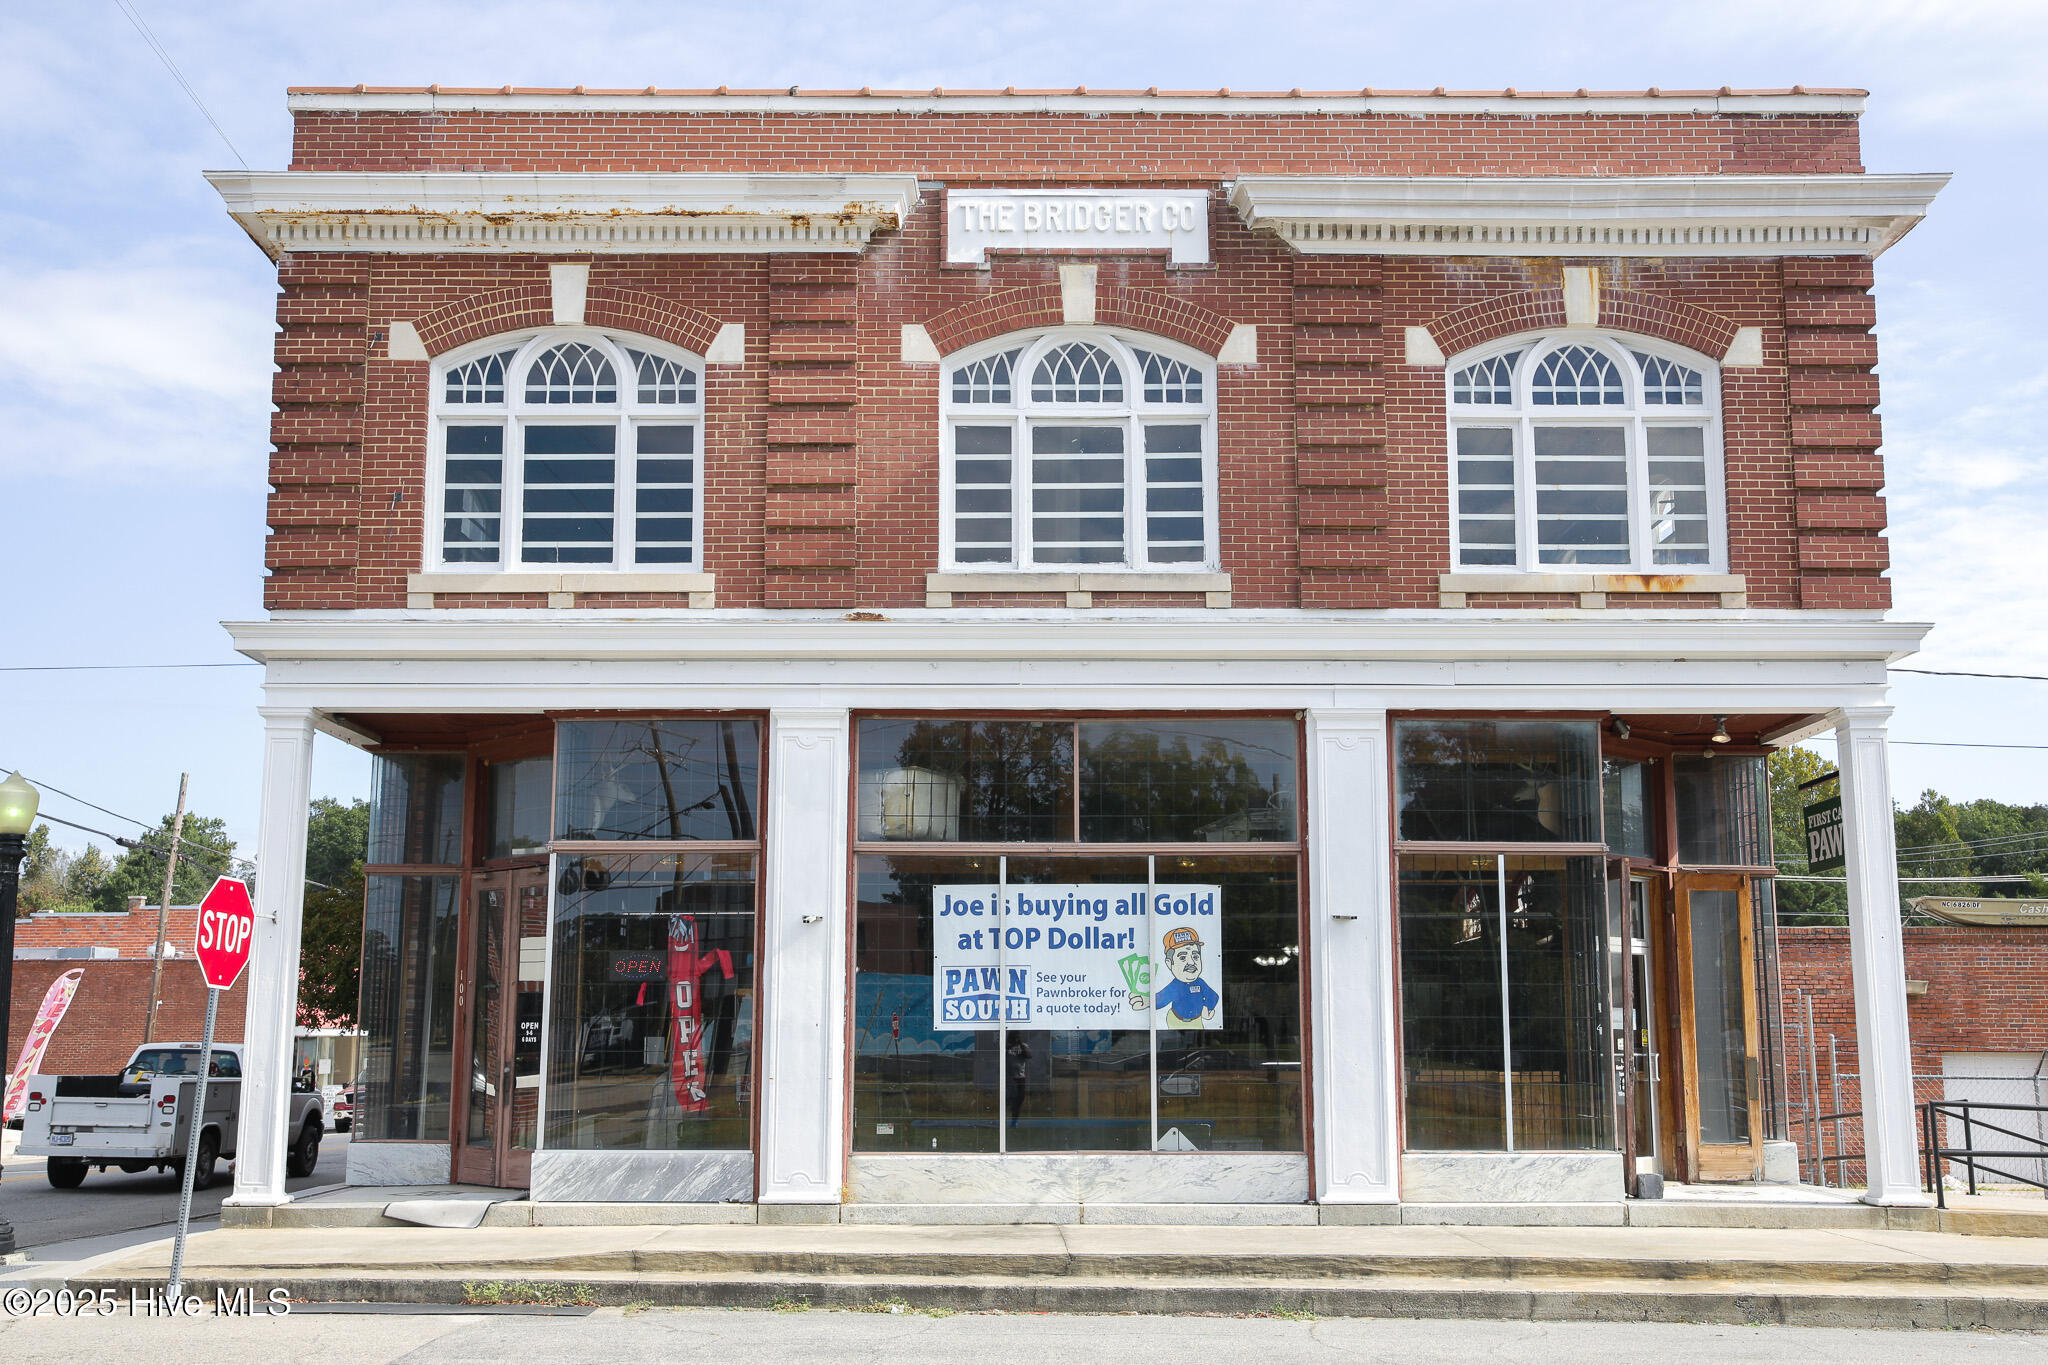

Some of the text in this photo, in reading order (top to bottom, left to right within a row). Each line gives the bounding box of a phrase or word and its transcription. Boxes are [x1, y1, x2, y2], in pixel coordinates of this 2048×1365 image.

[960, 201, 1196, 233] THE BRIDGER CO
[1808, 809, 1832, 828] FIRST
[940, 894, 984, 916] Joe
[1018, 893, 1108, 921] buying
[1115, 893, 1145, 915] all
[1154, 893, 1214, 916] Gold
[2019, 903, 2048, 914] Cash
[200, 909, 251, 954] STOP
[958, 926, 1135, 950] at TOP Dollar!
[615, 960, 662, 973] OPEN
[945, 967, 1027, 995] PAWN
[1036, 972, 1087, 984] See your
[1036, 986, 1126, 998] Pawnbroker for
[1036, 1003, 1121, 1016] a quote today!
[521, 1022, 539, 1030] OPEN
